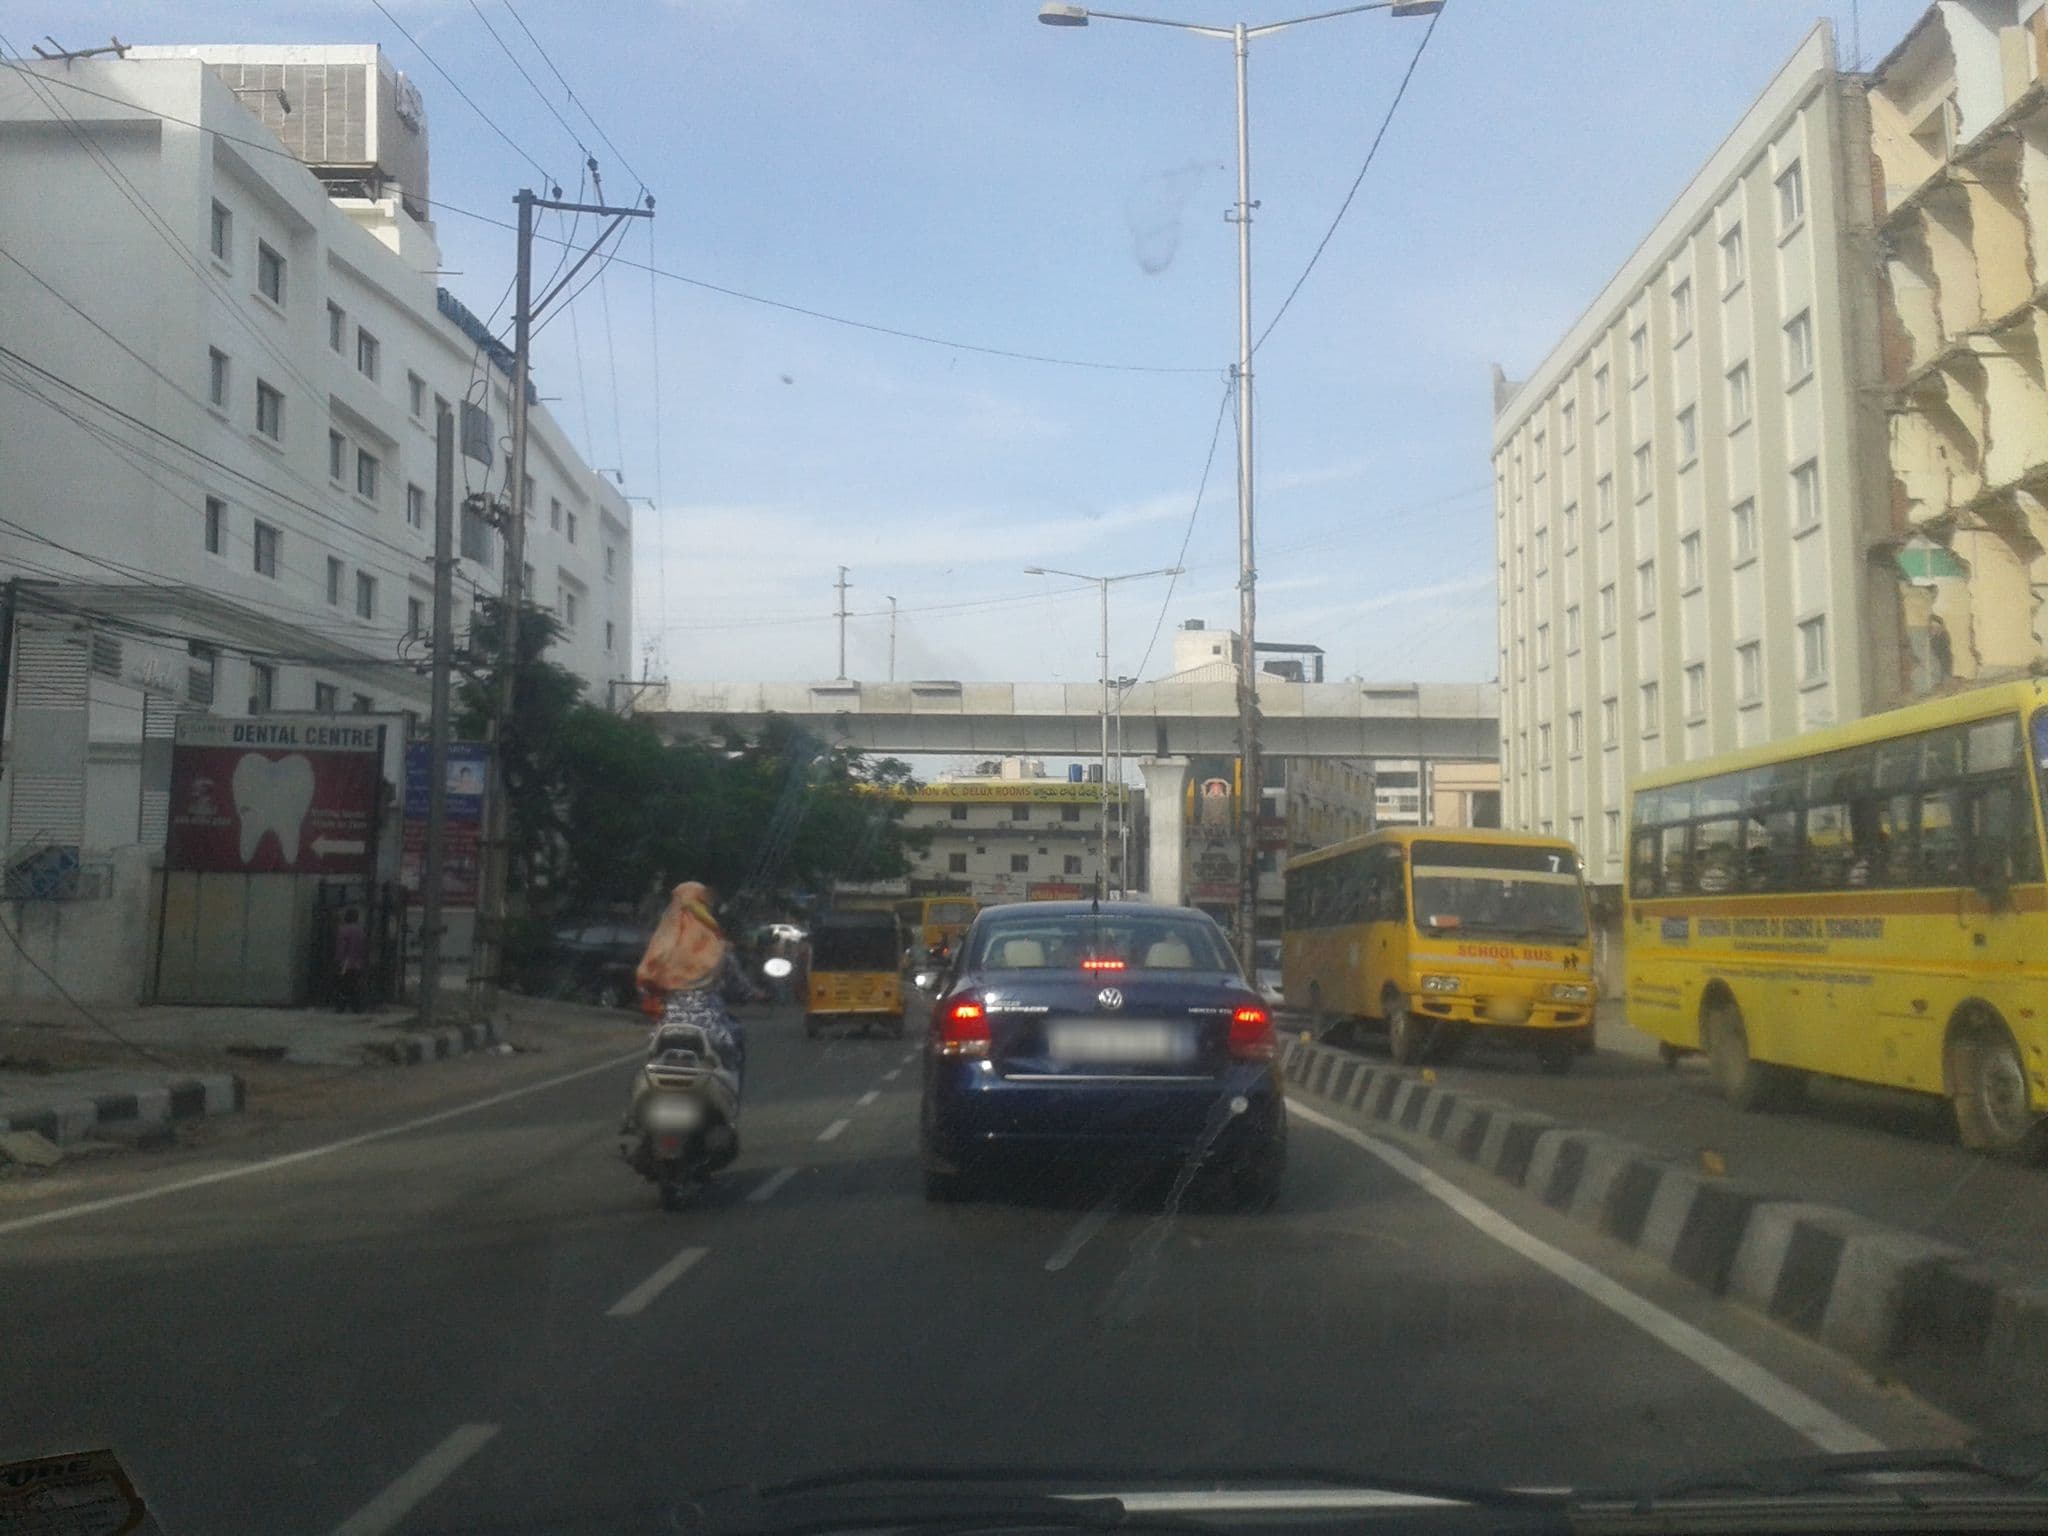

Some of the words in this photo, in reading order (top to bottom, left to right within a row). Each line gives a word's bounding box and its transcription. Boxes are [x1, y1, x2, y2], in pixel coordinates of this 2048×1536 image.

[233, 724, 299, 743] DENTAL
[305, 726, 374, 746] CENTRE
[962, 785, 993, 797] DELUX
[996, 786, 1031, 797] ROOMS
[1548, 855, 1560, 872] 7
[1458, 944, 1517, 960] SCHOOL
[1522, 948, 1553, 962] BUS
